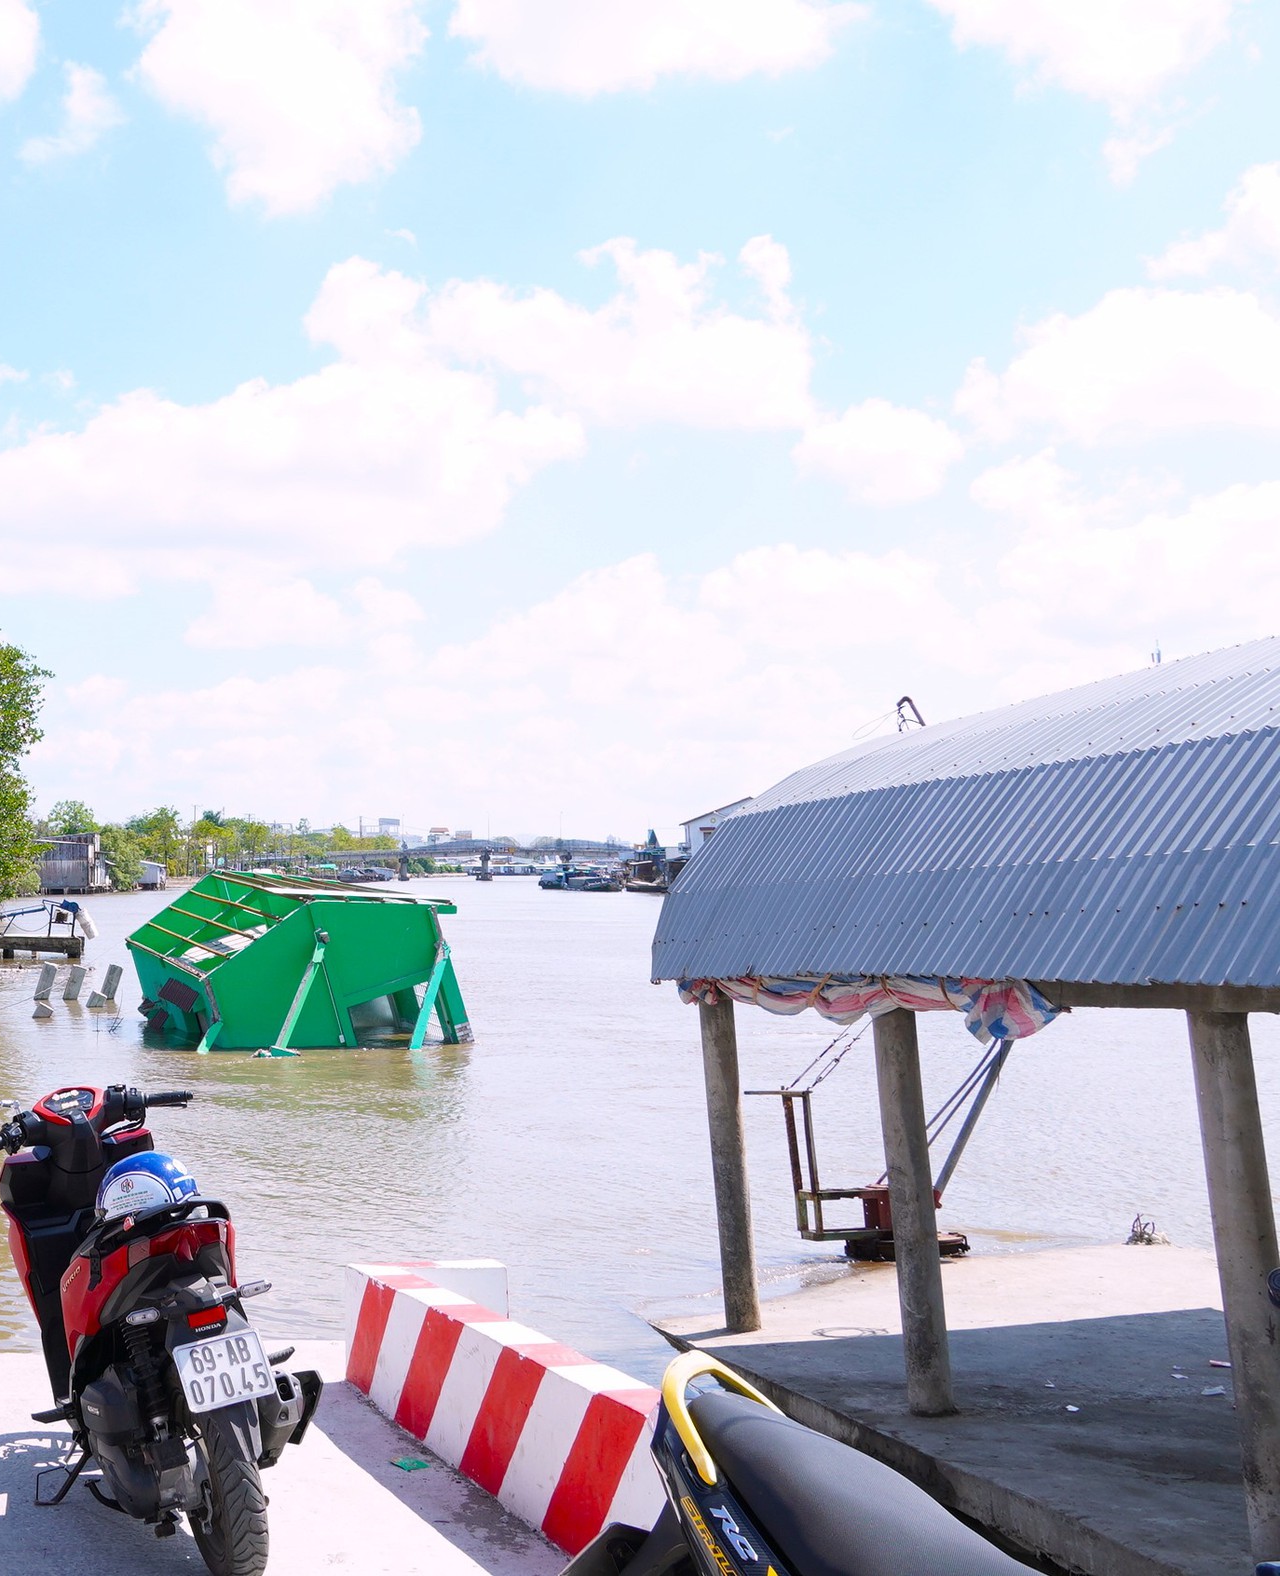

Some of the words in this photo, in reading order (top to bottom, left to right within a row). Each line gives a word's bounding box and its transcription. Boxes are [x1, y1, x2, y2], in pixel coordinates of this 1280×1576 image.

[195, 1322, 222, 1333] HONDA
[189, 1336, 252, 1374] 69-AB
[189, 1362, 269, 1406] 070.45
